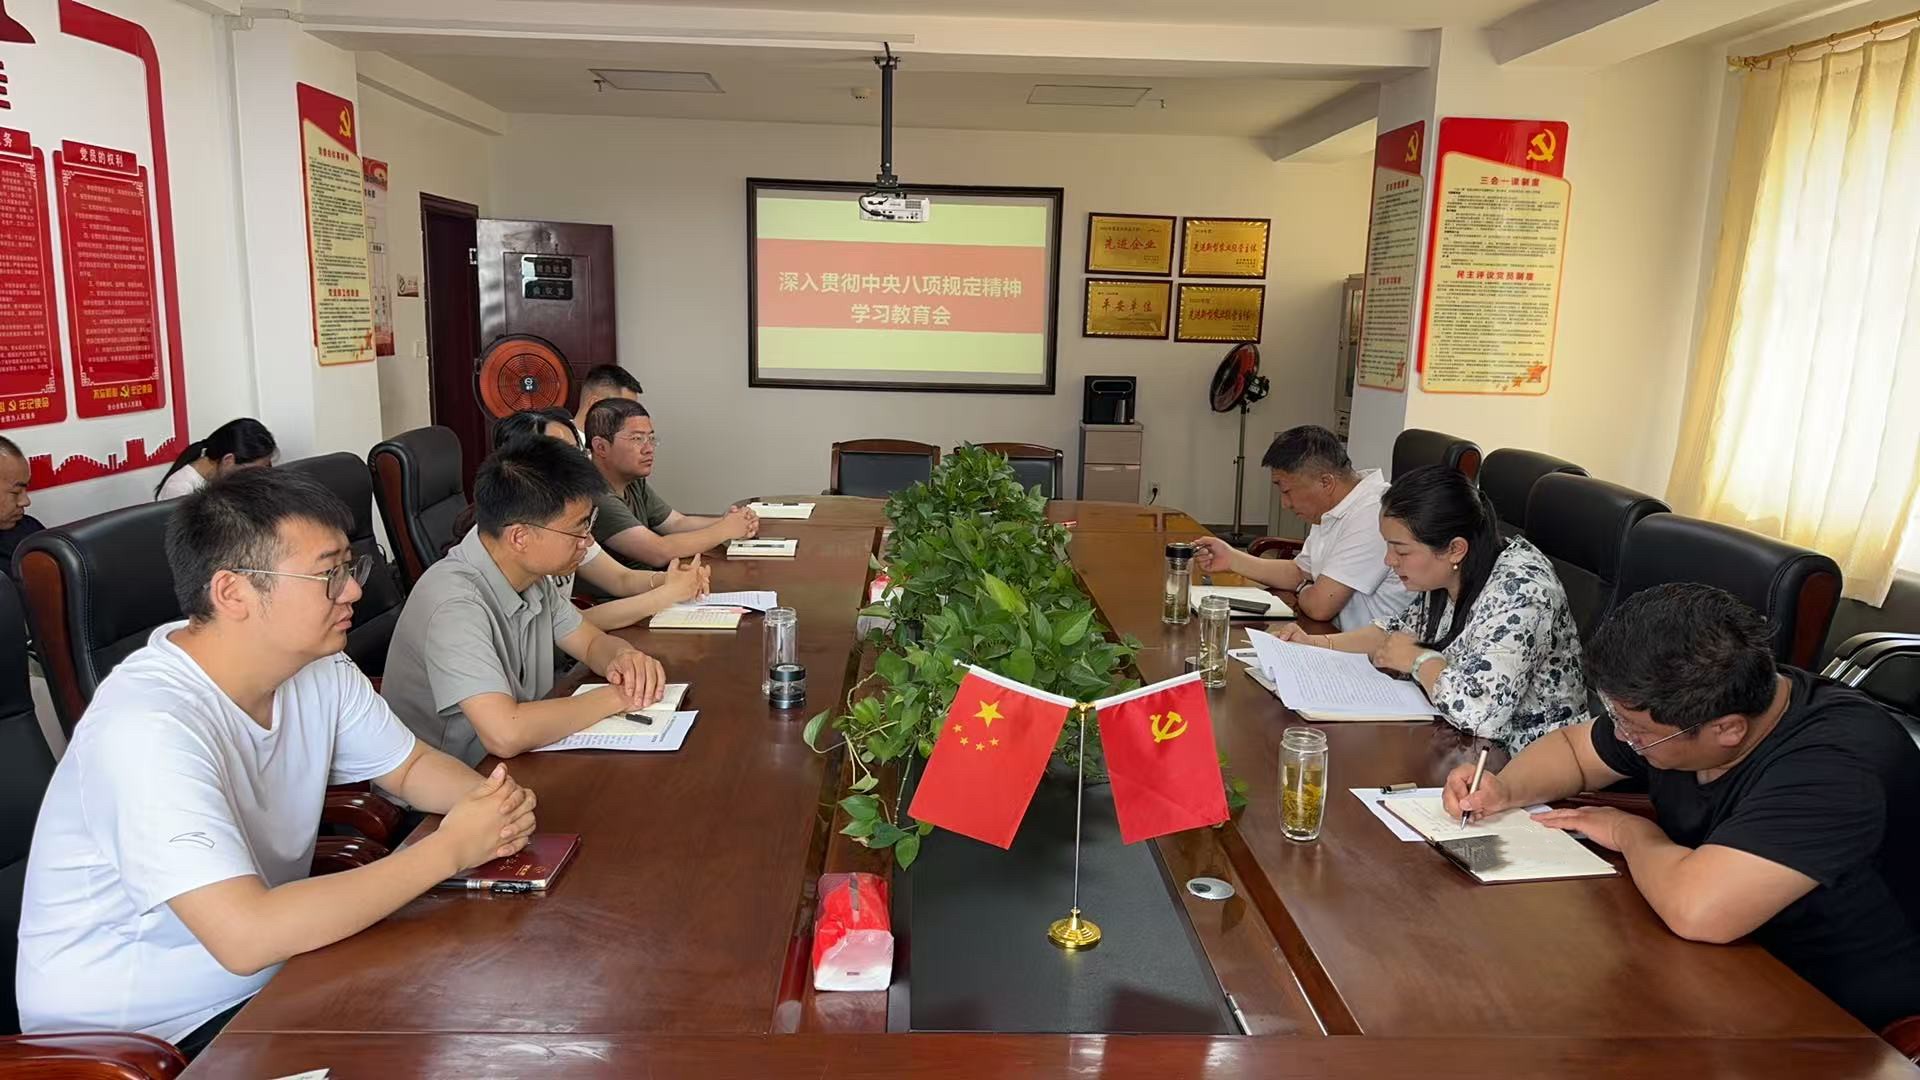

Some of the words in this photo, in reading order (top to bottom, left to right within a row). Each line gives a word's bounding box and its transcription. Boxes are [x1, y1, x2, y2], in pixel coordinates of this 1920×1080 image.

[79, 146, 124, 167] 党员的权利
[1480, 176, 1540, 187] 三会一课制度
[1104, 236, 1157, 250] 先进企业
[1457, 270, 1535, 281] 民主评议党员制度
[778, 271, 1022, 298] 深入贯彻中央八项规定精神
[851, 304, 951, 325] 学习教育会
